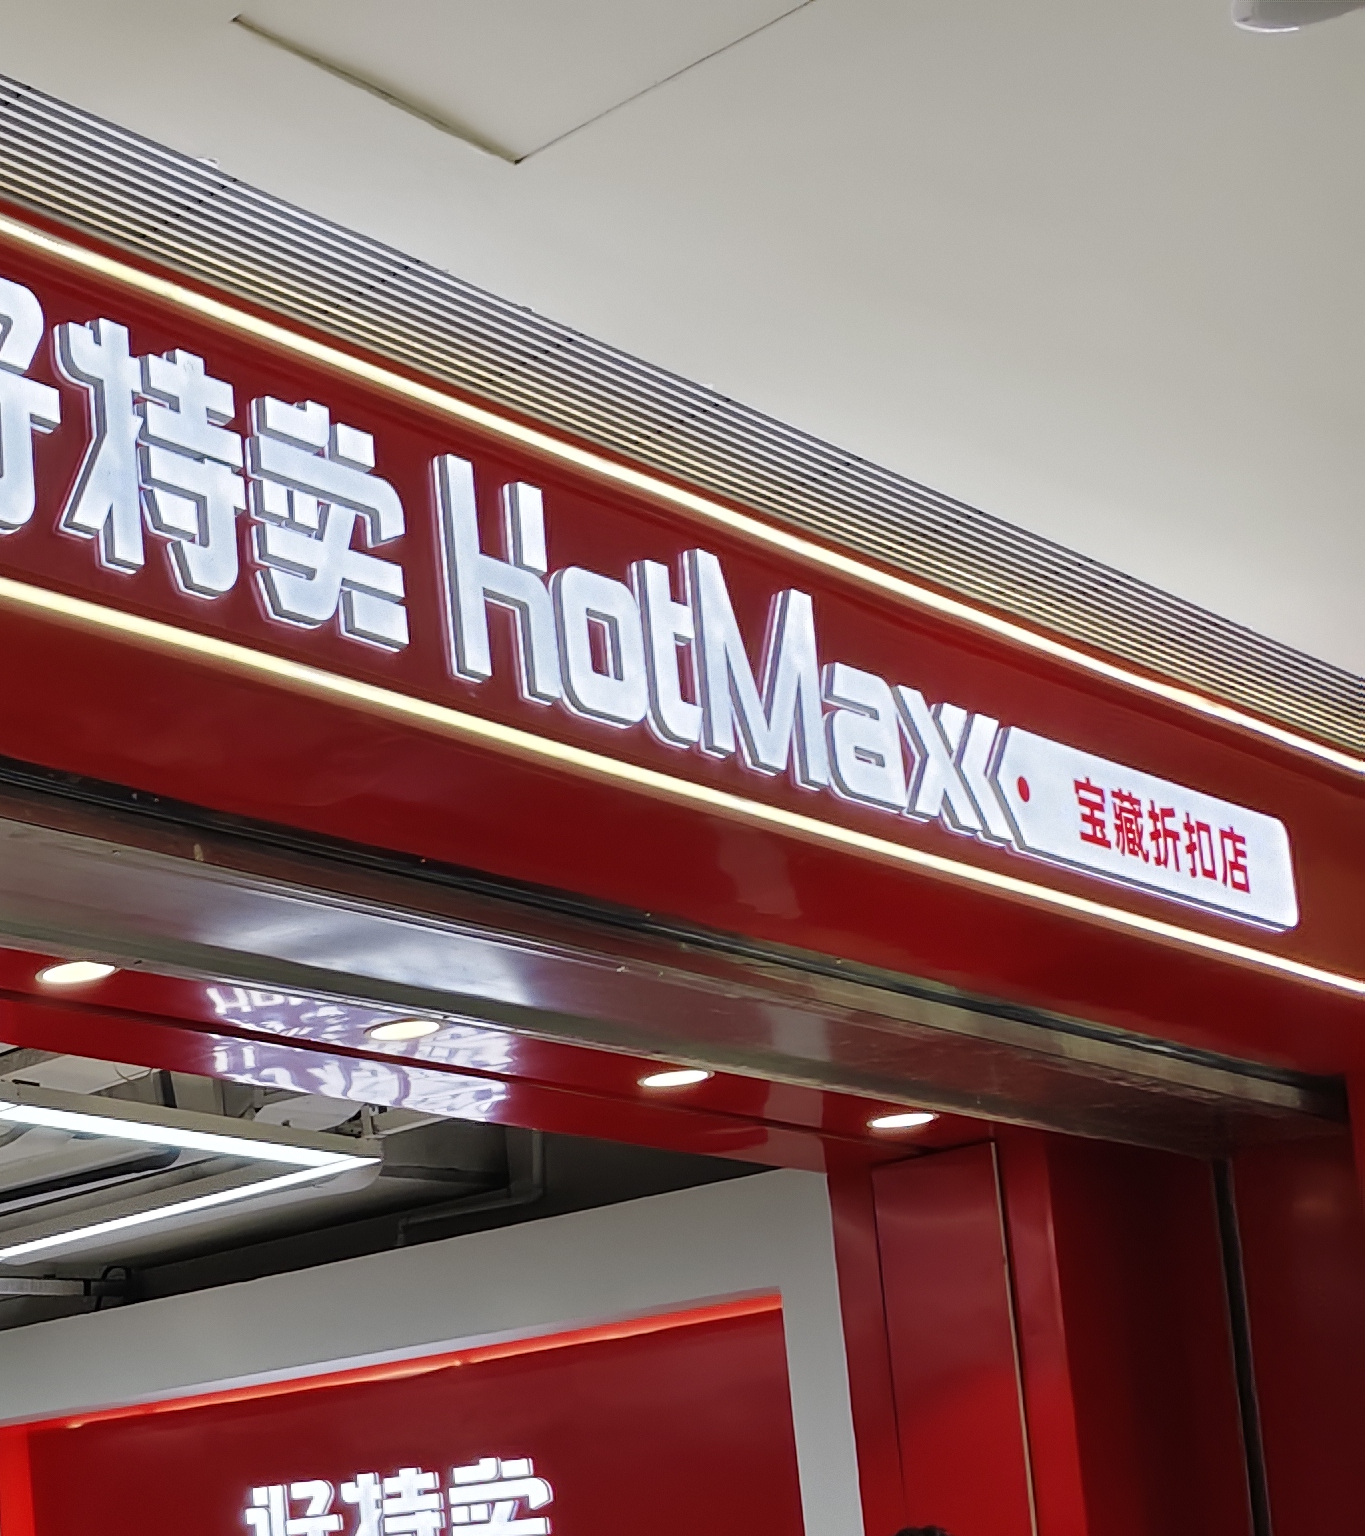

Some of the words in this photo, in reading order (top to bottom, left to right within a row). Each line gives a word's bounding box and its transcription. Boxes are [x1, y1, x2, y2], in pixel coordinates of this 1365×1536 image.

[1073, 780, 1251, 893] 宝藏折扣店
